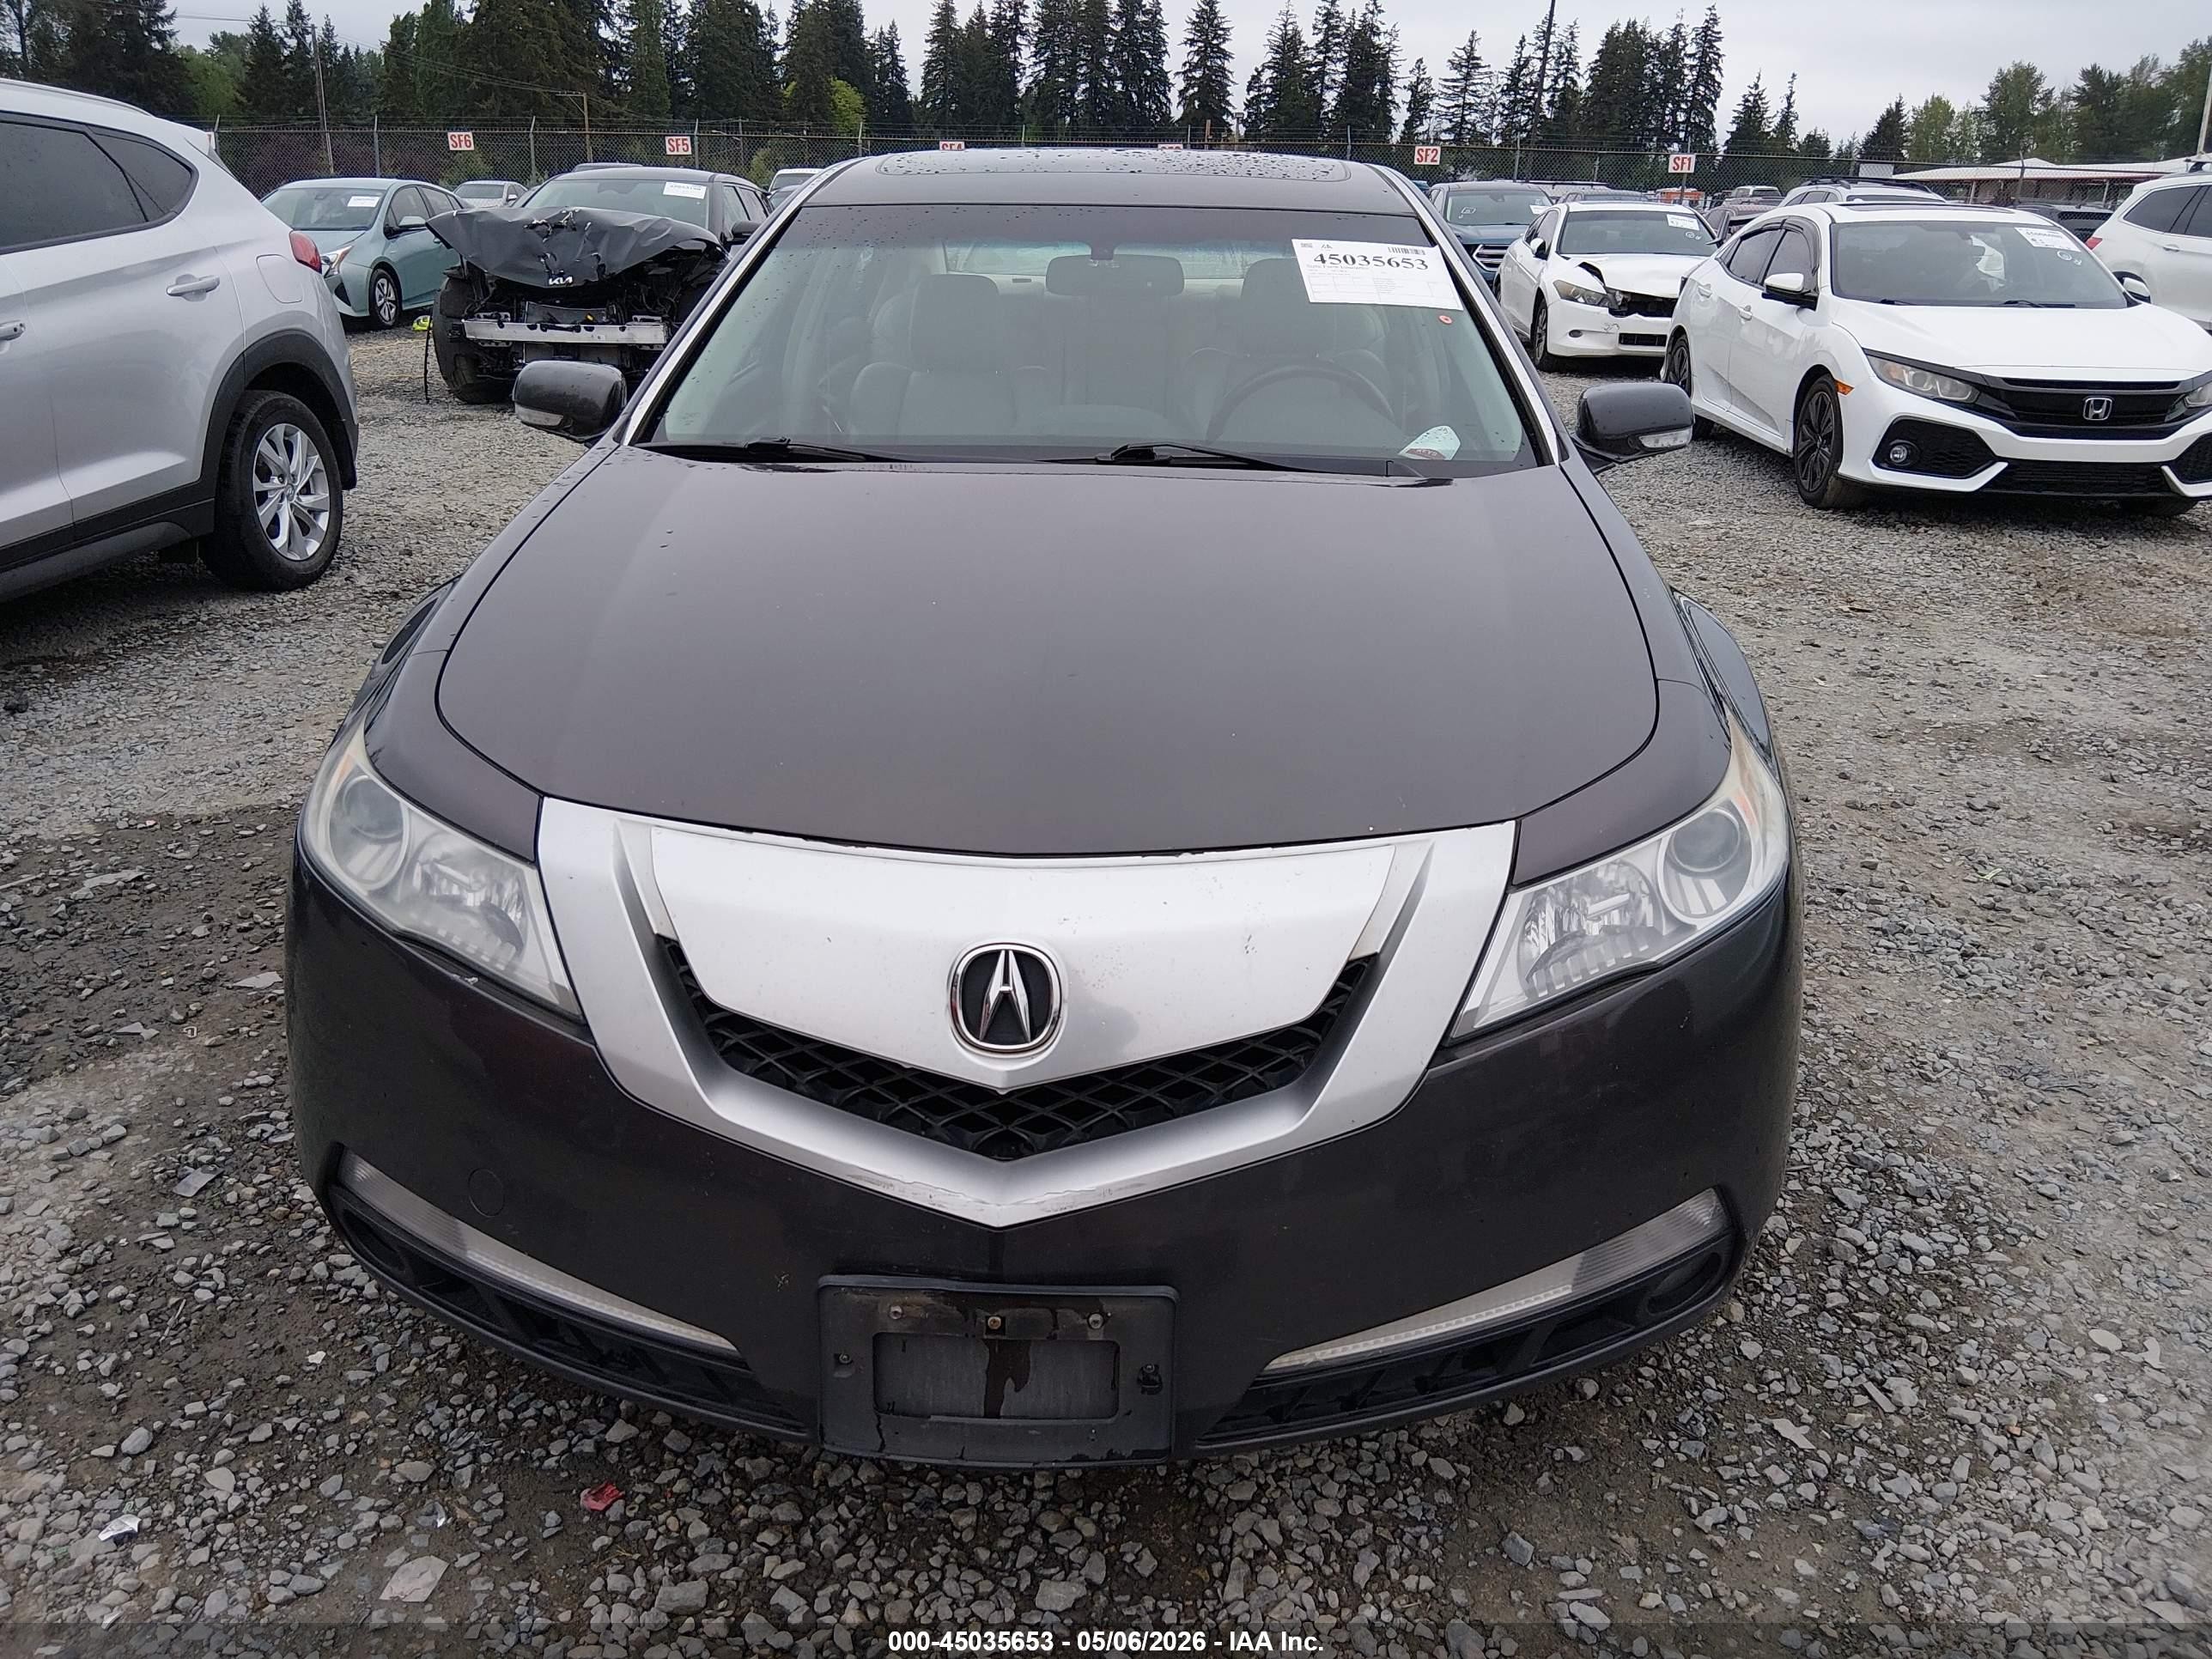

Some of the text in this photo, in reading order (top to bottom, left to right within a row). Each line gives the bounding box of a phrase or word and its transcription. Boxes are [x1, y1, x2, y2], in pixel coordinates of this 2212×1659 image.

[450, 134, 472, 149] SF6
[667, 137, 690, 153] SF5
[1417, 148, 1439, 163] SF2
[1672, 156, 1692, 171] SF1
[1313, 252, 1429, 270] 45035653
